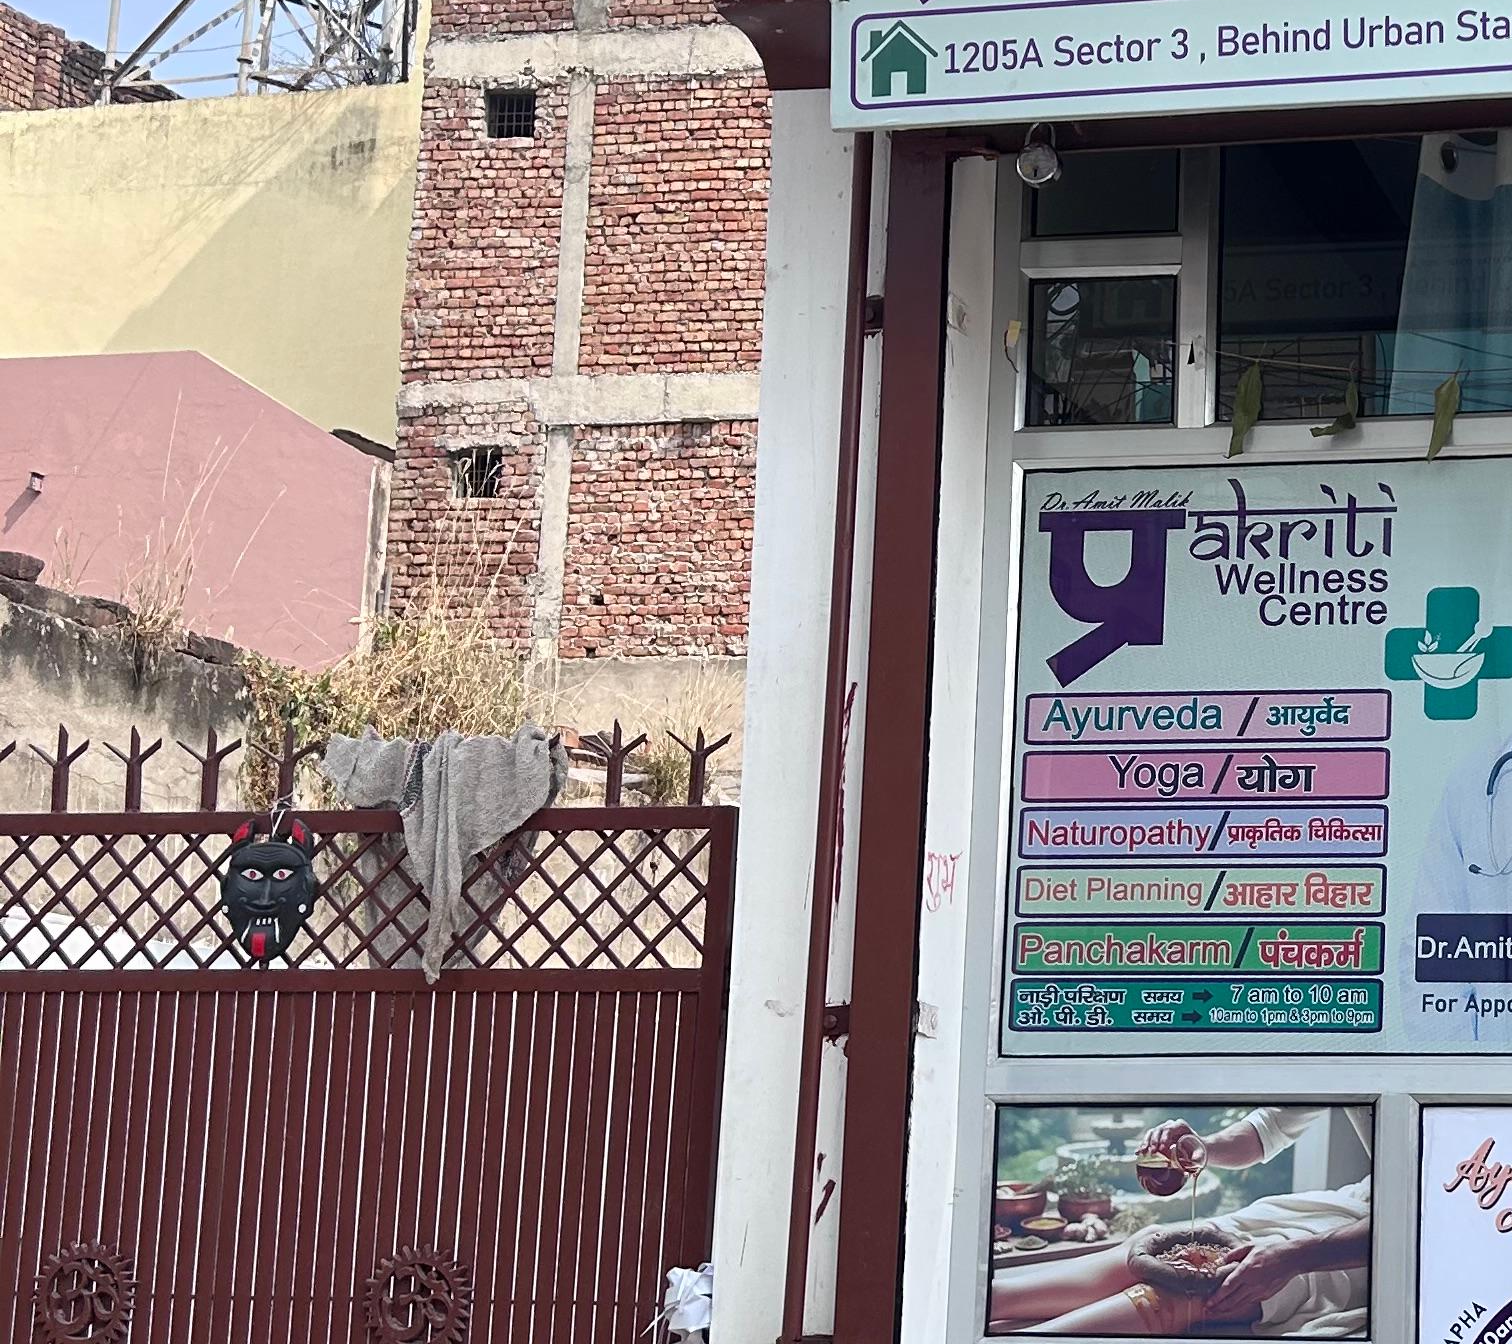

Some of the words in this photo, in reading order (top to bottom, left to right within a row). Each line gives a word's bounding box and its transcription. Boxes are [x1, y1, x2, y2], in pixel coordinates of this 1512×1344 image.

[945, 39, 1043, 73] 1205A
[1054, 35, 1161, 66] Sector
[1218, 20, 1330, 56] Behind
[1344, 16, 1443, 48] Urban
[1215, 563, 1388, 597] Wellness
[1260, 594, 1387, 626] Centre
[1042, 697, 1222, 740] Ayurveda
[1266, 697, 1351, 737] आयुर्वेद
[1108, 754, 1205, 797] Yoga
[1236, 754, 1316, 793] योग
[1308, 817, 1383, 843] चिकित्सा
[1025, 878, 1077, 901] Diet
[1304, 872, 1374, 907] विहार
[1141, 990, 1184, 1004] समय
[1231, 985, 1242, 1003] 7
[1248, 989, 1278, 1004] am
[1283, 985, 1300, 1004] to
[1308, 985, 1331, 1004] 10
[1338, 988, 1368, 1004] am
[1422, 995, 1458, 1012] For
